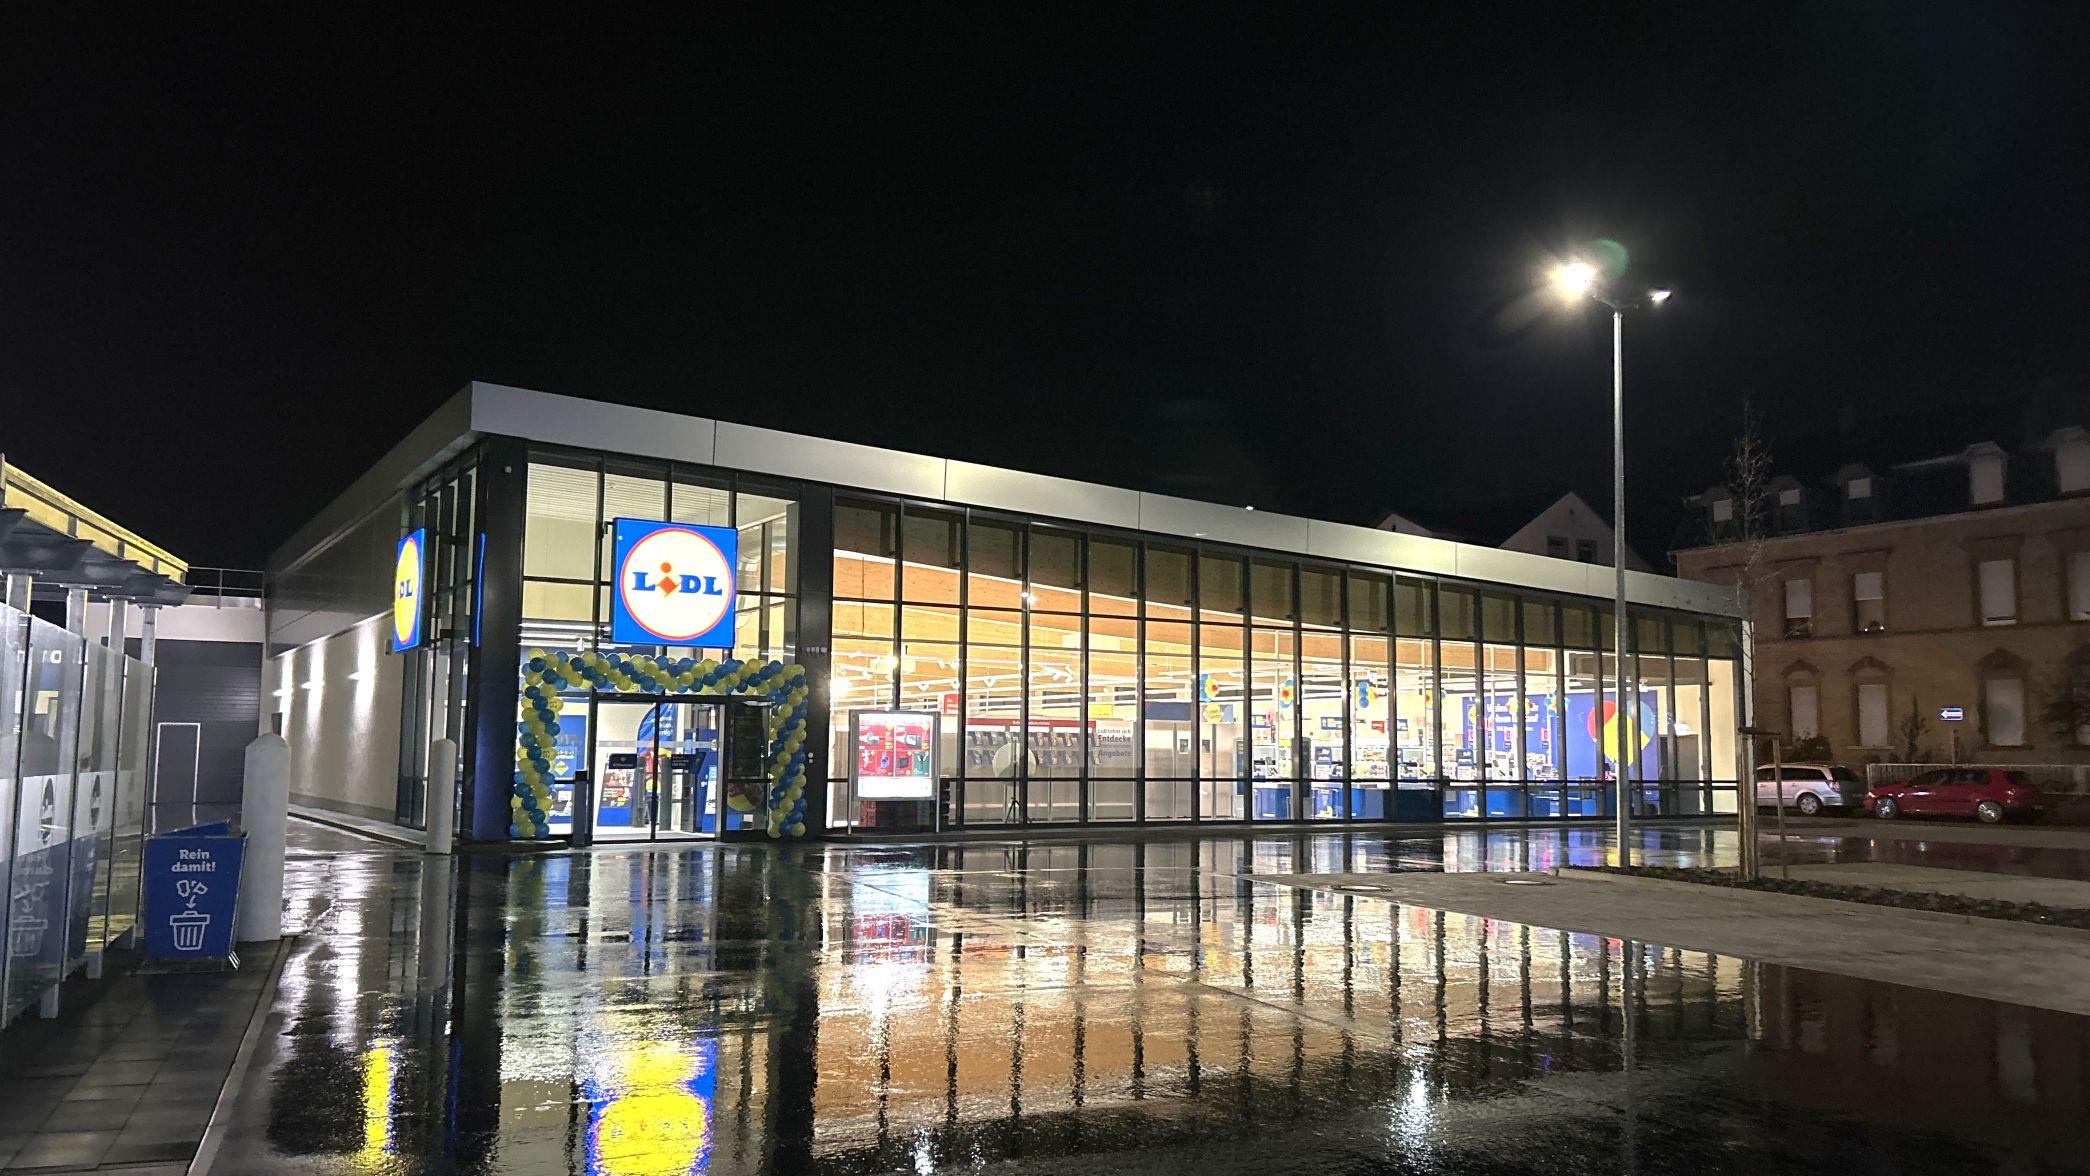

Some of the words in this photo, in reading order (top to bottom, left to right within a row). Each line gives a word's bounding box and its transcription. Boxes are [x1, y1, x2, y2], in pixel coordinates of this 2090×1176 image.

[1098, 734, 1131, 742] Entdecke
[179, 849, 210, 860] Rein
[171, 861, 216, 872] damit!
